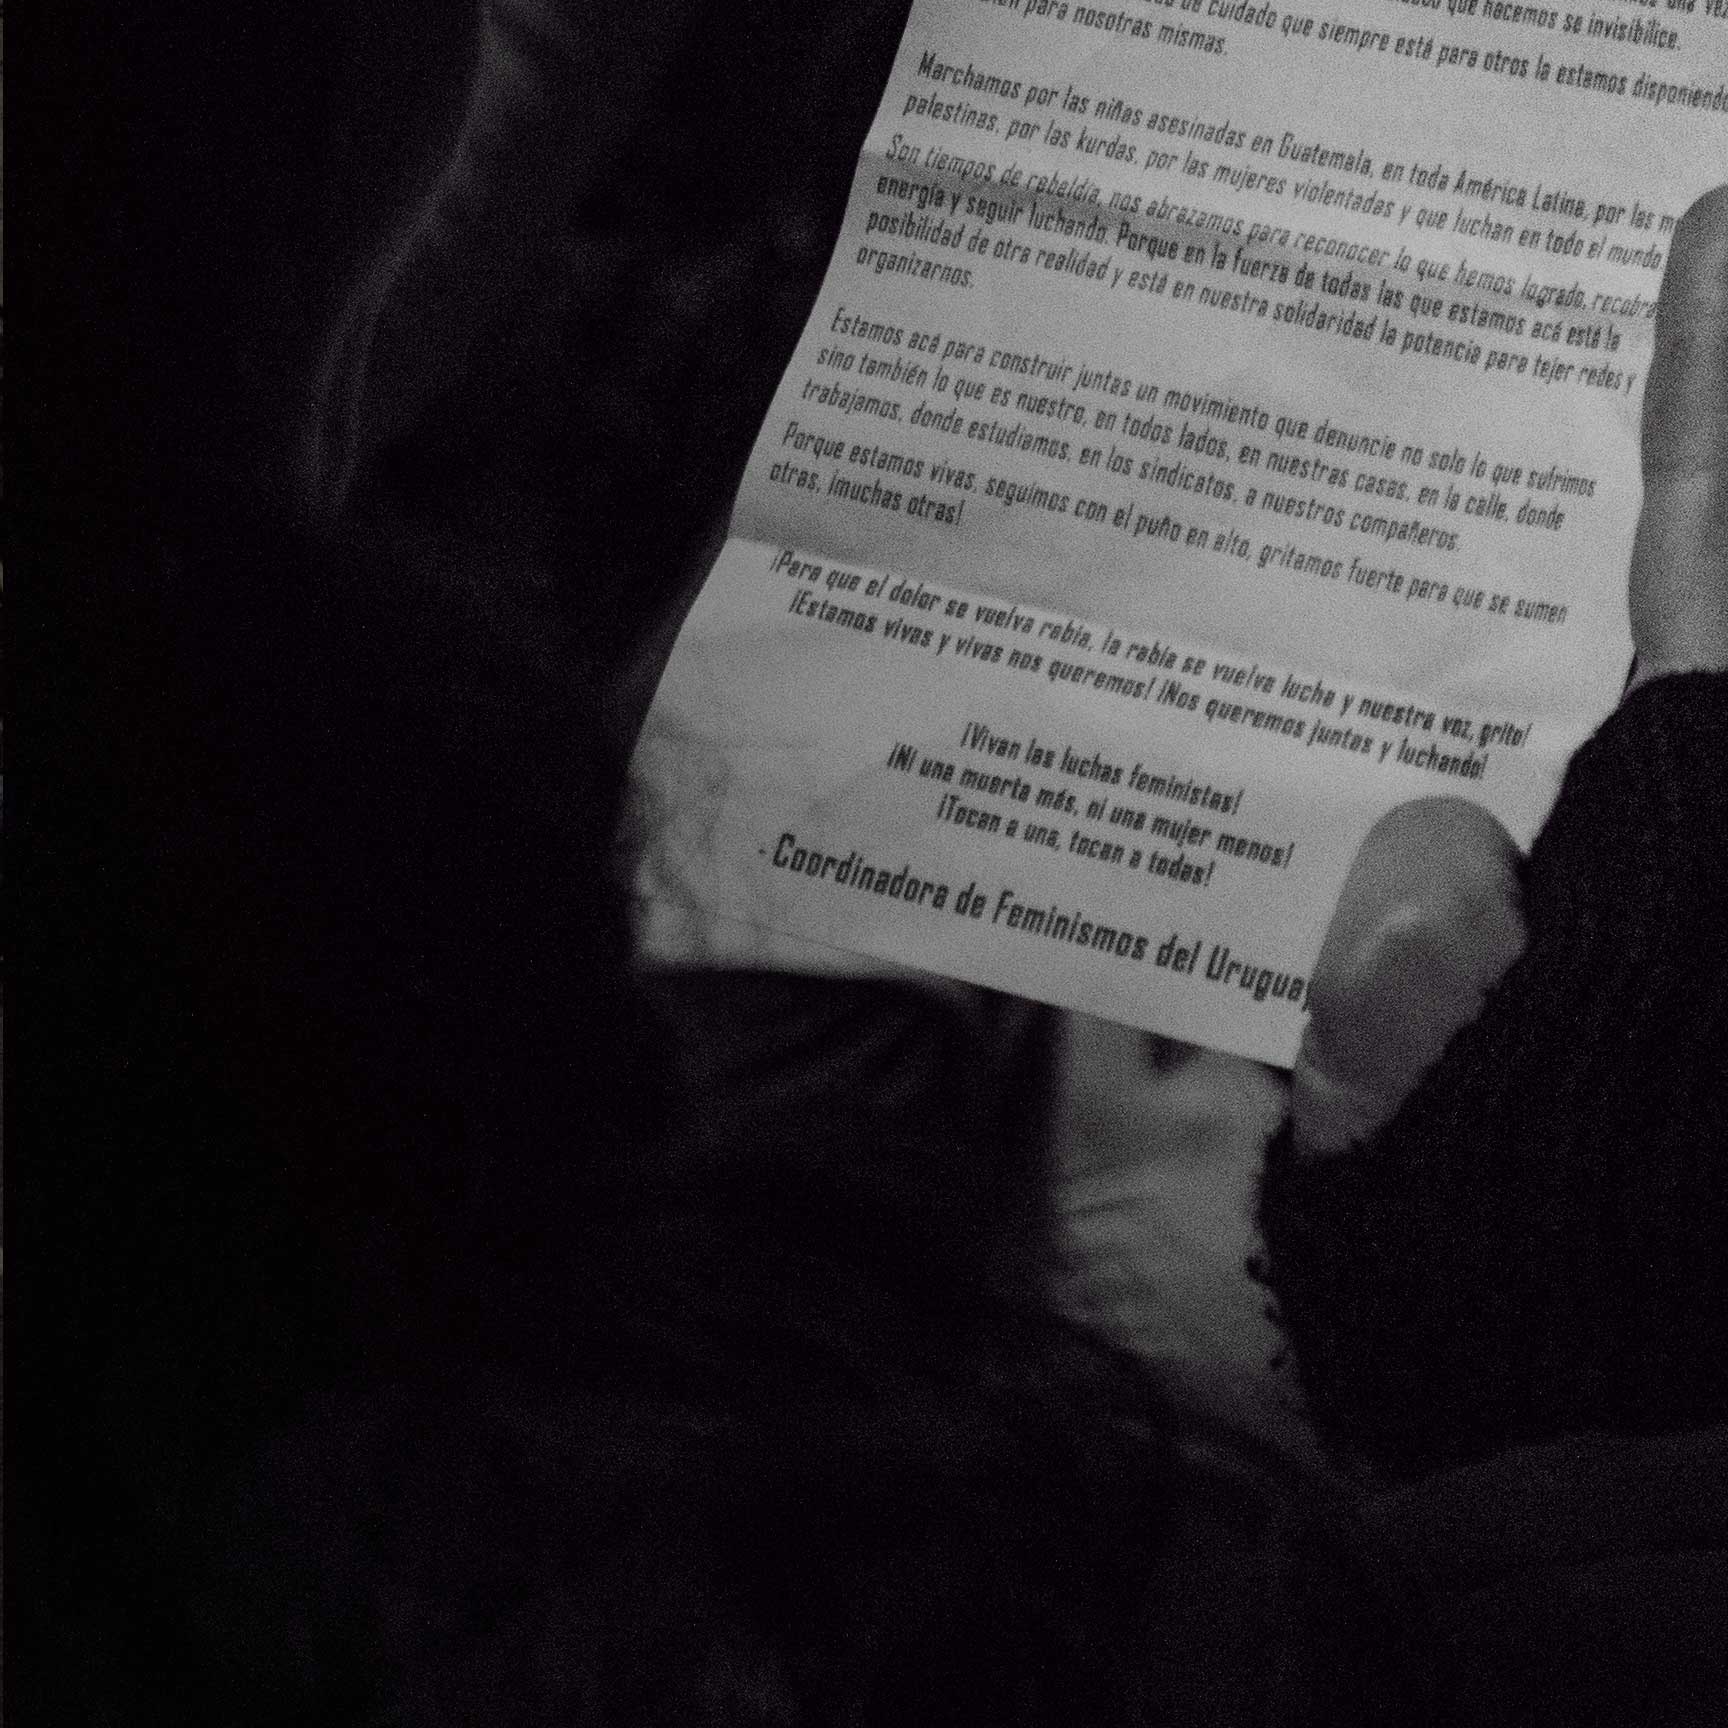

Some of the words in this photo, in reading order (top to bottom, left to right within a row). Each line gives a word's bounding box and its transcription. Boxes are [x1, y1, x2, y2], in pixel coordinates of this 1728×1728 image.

[1072, 5, 1153, 40] nosotras
[1561, 12, 1584, 35] se
[864, 210, 966, 249] posibilidad
[965, 227, 991, 256] de
[992, 237, 1032, 265] otra
[1035, 247, 1112, 281] realidad
[1109, 267, 1124, 290] y
[1126, 269, 1169, 295] está
[1171, 279, 1196, 300] en
[1198, 286, 1270, 318] nuestra
[1272, 299, 1378, 342] solidaridad
[1378, 318, 1399, 347] la
[1399, 330, 1482, 365] potencia
[1483, 349, 1529, 374] para
[1532, 354, 1576, 385] tejer
[1577, 362, 1624, 391] redes
[1623, 372, 1637, 397] y
[829, 305, 905, 347] Estamos
[907, 330, 942, 355] acá
[940, 339, 986, 365] para
[988, 349, 1073, 382] construir
[1071, 364, 1133, 398] juntas
[1134, 383, 1160, 403] un
[1163, 388, 1270, 431] movimiento
[1273, 415, 1310, 441] que
[1312, 419, 1397, 460] denuncie
[1400, 444, 1425, 467] no
[1427, 447, 1467, 475] solo
[1468, 450, 1488, 480] lo
[1490, 463, 1524, 487] que
[1526, 464, 1597, 498] sufrimos
[824, 569, 863, 593] que
[863, 573, 890, 599] el
[887, 578, 942, 612] dolor
[943, 598, 970, 620] se
[974, 602, 1035, 635] vuelva
[1100, 629, 1123, 657] la
[1124, 641, 1178, 670] rabia
[1180, 655, 1207, 677] se
[1212, 663, 1277, 694] vuelva
[1280, 673, 1337, 709] lucha
[1338, 693, 1355, 718] y
[1357, 697, 1436, 732] nuestra
[882, 617, 934, 648] vivas
[935, 632, 952, 656] y
[954, 635, 1005, 664] vivas
[1006, 648, 1044, 673] nos
[1204, 697, 1306, 739] queremos
[1306, 719, 1374, 755] juntas
[1377, 740, 1394, 764] y
[918, 757, 956, 784] una
[958, 767, 1032, 803] muerte
[1085, 797, 1108, 821] ni
[1108, 806, 1148, 832] una
[1150, 815, 1213, 848] mujer
[1024, 737, 1056, 770] las
[1059, 746, 1124, 786] luchas
[1004, 818, 1020, 839] a
[1068, 830, 1125, 864] tocan
[1127, 848, 1143, 870] a
[772, 831, 950, 910] Coordinadora
[953, 881, 988, 919] de
[992, 889, 1149, 961] Feminismos
[1154, 933, 1203, 975] del
